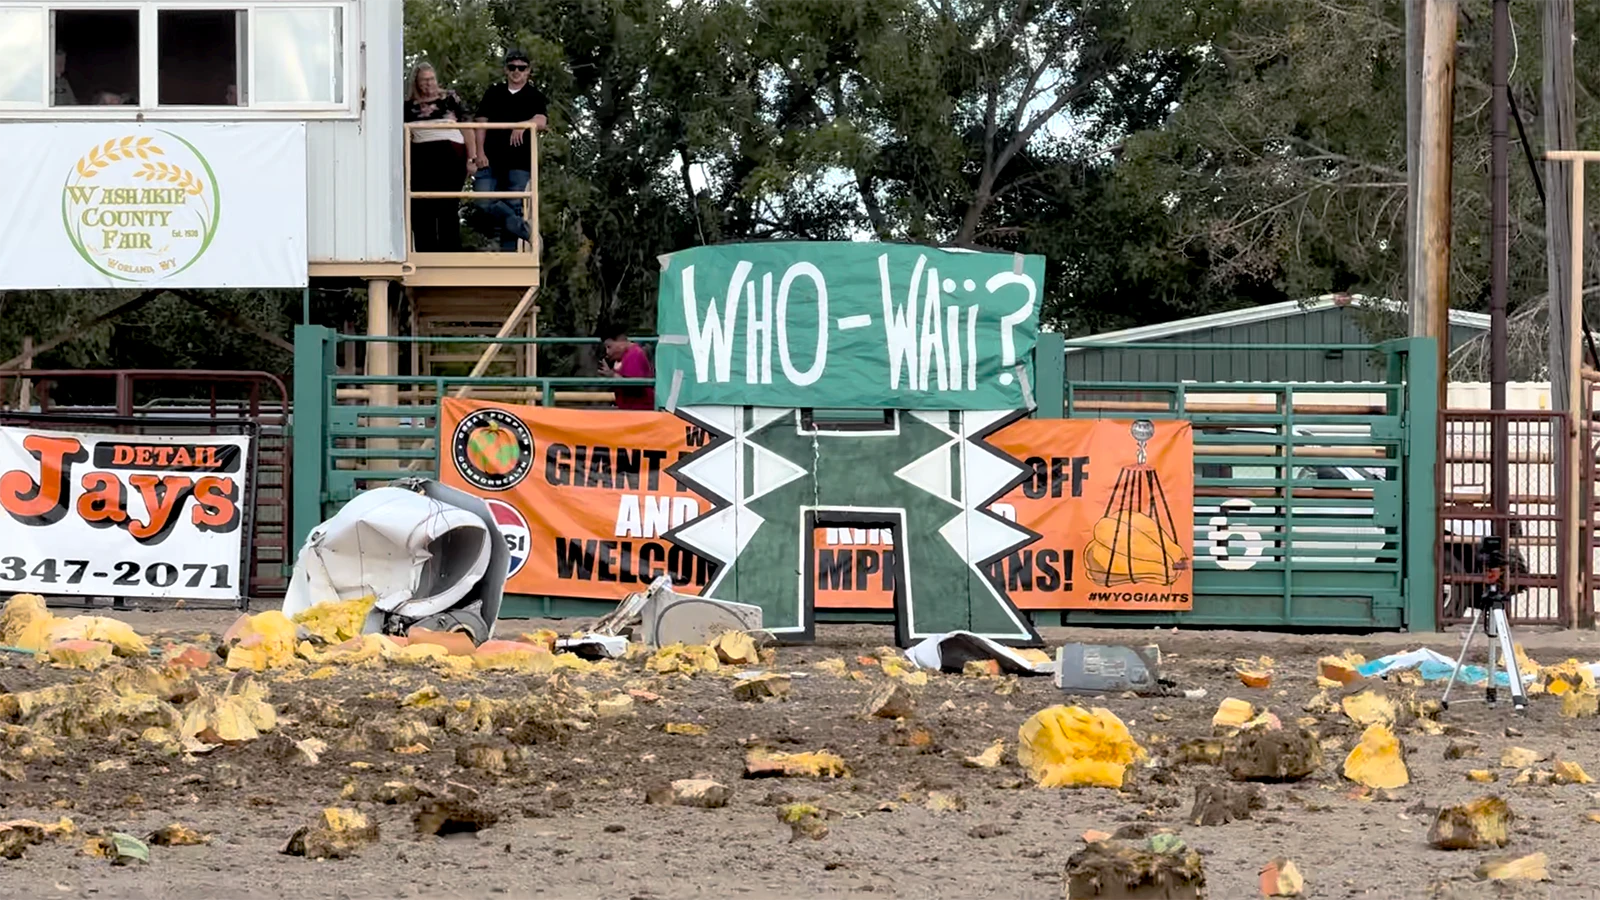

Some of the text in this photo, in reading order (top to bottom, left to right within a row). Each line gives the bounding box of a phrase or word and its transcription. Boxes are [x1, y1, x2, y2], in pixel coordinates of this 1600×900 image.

[81, 207, 173, 227] COUNTY
[102, 229, 153, 250] FAIR
[112, 444, 222, 468] DETAIL
[544, 442, 667, 492] GIANT
[1022, 456, 1090, 500] OFF
[0, 434, 239, 546] Jays
[0, 556, 233, 589] 347-2071
[1088, 592, 1189, 603] #WYOGIANTS
